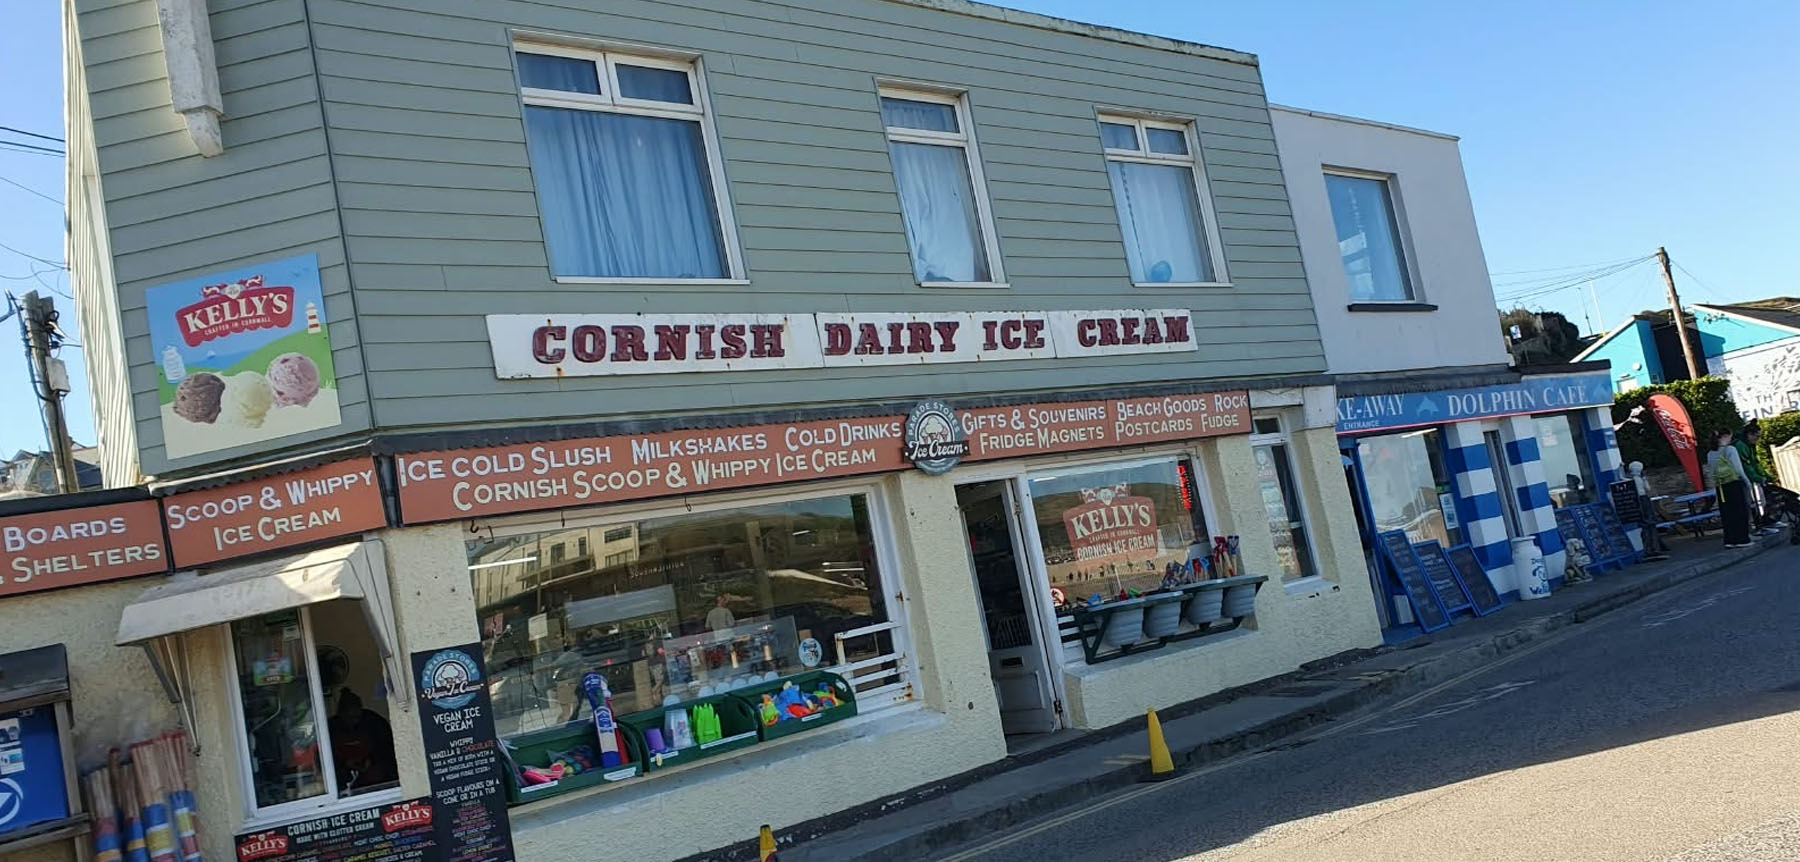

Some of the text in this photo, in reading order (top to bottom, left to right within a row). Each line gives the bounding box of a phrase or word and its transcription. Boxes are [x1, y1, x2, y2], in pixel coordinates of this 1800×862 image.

[183, 293, 288, 333] KELLY'S
[532, 315, 1190, 364] CORNISH DAIRY ICE CREAM
[1116, 393, 1247, 421] BEACH GOODS ROCK
[1447, 387, 1536, 417] DOLPHIN
[1543, 384, 1590, 407] CAFE
[908, 402, 960, 436] PARADE STORES
[961, 404, 1107, 436] GIFTS & SOUVENIRS
[1115, 413, 1240, 442] POSTCARDS FUDGE
[1343, 419, 1381, 430] ENTRANCE
[398, 420, 902, 488] ICE COLD SLUSH MILKSHAKES COLD DRINKS
[908, 439, 964, 460] Ice Cream
[979, 424, 1105, 456] FRIDGE MAGNETS
[451, 446, 877, 512] CORNISH SCOOP & WHIPPY ICE CREAM
[167, 467, 374, 530] SCOOP & WHIPPY
[3, 516, 127, 553] BOARDS
[213, 507, 343, 553] ICE CREAM
[1071, 502, 1152, 540] KELLY'S
[11, 542, 162, 583] SHELTERS
[1076, 533, 1156, 561] CORNISH ICE CREAM
[433, 706, 481, 725] VEGAN ICE
[444, 719, 474, 733] CREAM
[429, 749, 455, 760] VANILLA
[462, 740, 495, 753] CHOCOLATE
[436, 787, 456, 799] SCOOP
[457, 781, 485, 794] FLAVOURS
[486, 779, 494, 787] ON
[443, 795, 459, 805] CONE
[460, 792, 469, 800] OR
[470, 790, 478, 799] IN
[484, 786, 496, 795] TUB
[287, 806, 431, 837] CORNISH ICE CREAM KELLY'S
[354, 822, 375, 832] CREAM
[241, 837, 287, 856] KELLY'S
